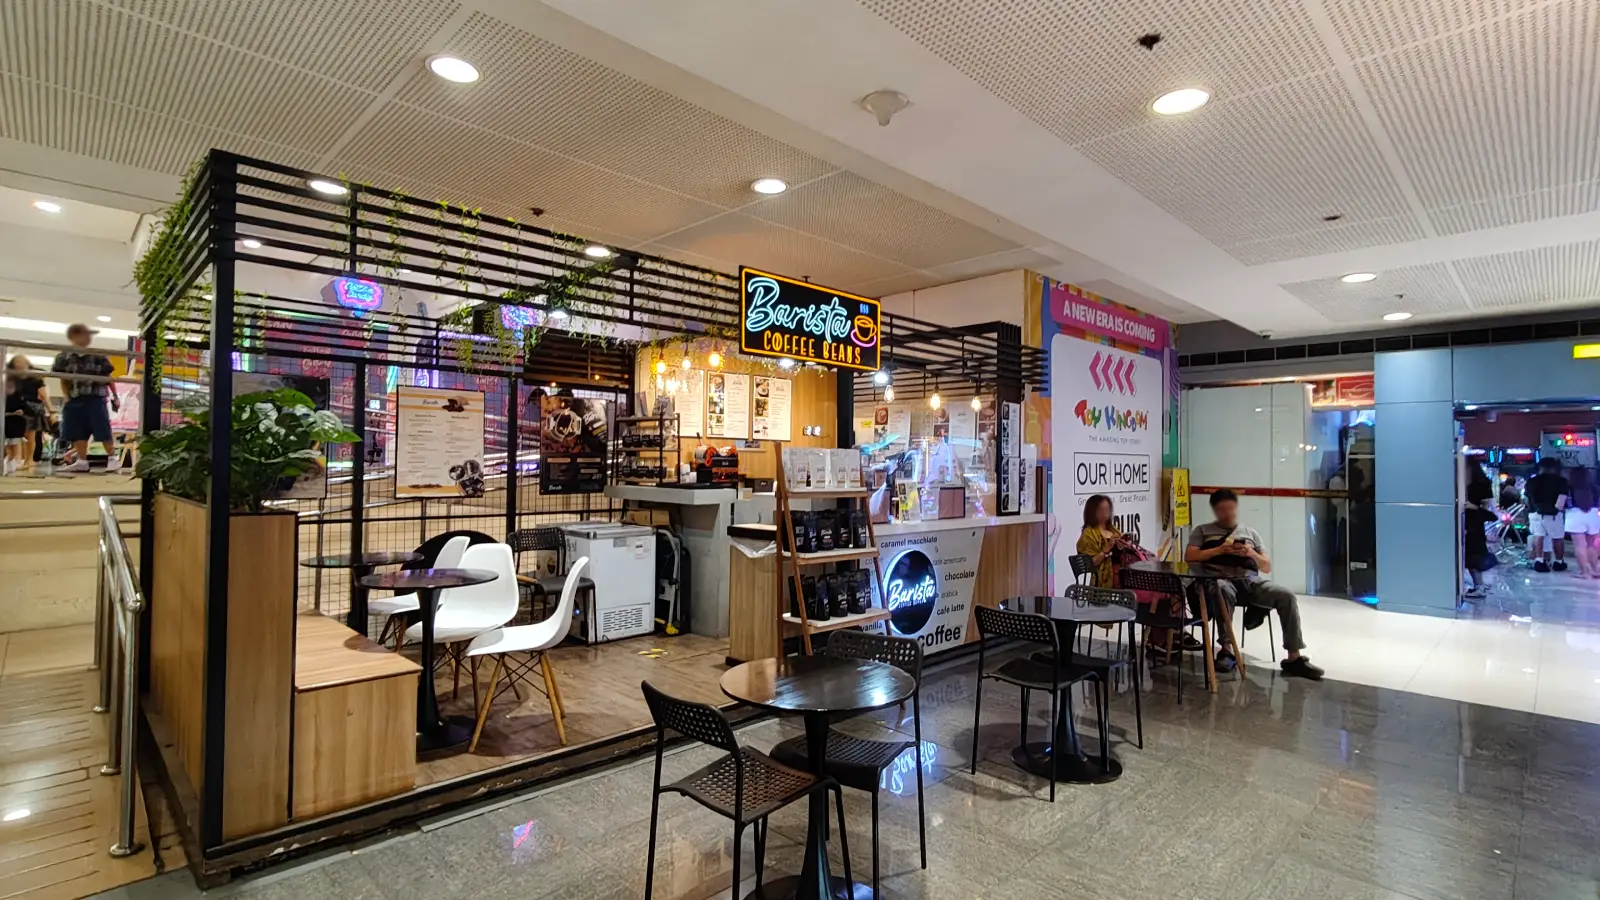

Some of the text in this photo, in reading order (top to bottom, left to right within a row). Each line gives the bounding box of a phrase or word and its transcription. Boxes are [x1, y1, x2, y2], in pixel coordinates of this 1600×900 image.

[746, 277, 851, 344] Barista
[1063, 300, 1155, 343] A NEW ERA IS COMING
[764, 330, 860, 364] COFFEE BEANS
[1077, 462, 1147, 485] OUR HOME
[881, 536, 938, 548] caramel macchiato
[945, 570, 975, 581] chocolate
[888, 575, 936, 611] Barista
[937, 603, 965, 616] cafe latte
[861, 621, 883, 632] vanilla
[917, 624, 961, 648] coffee
